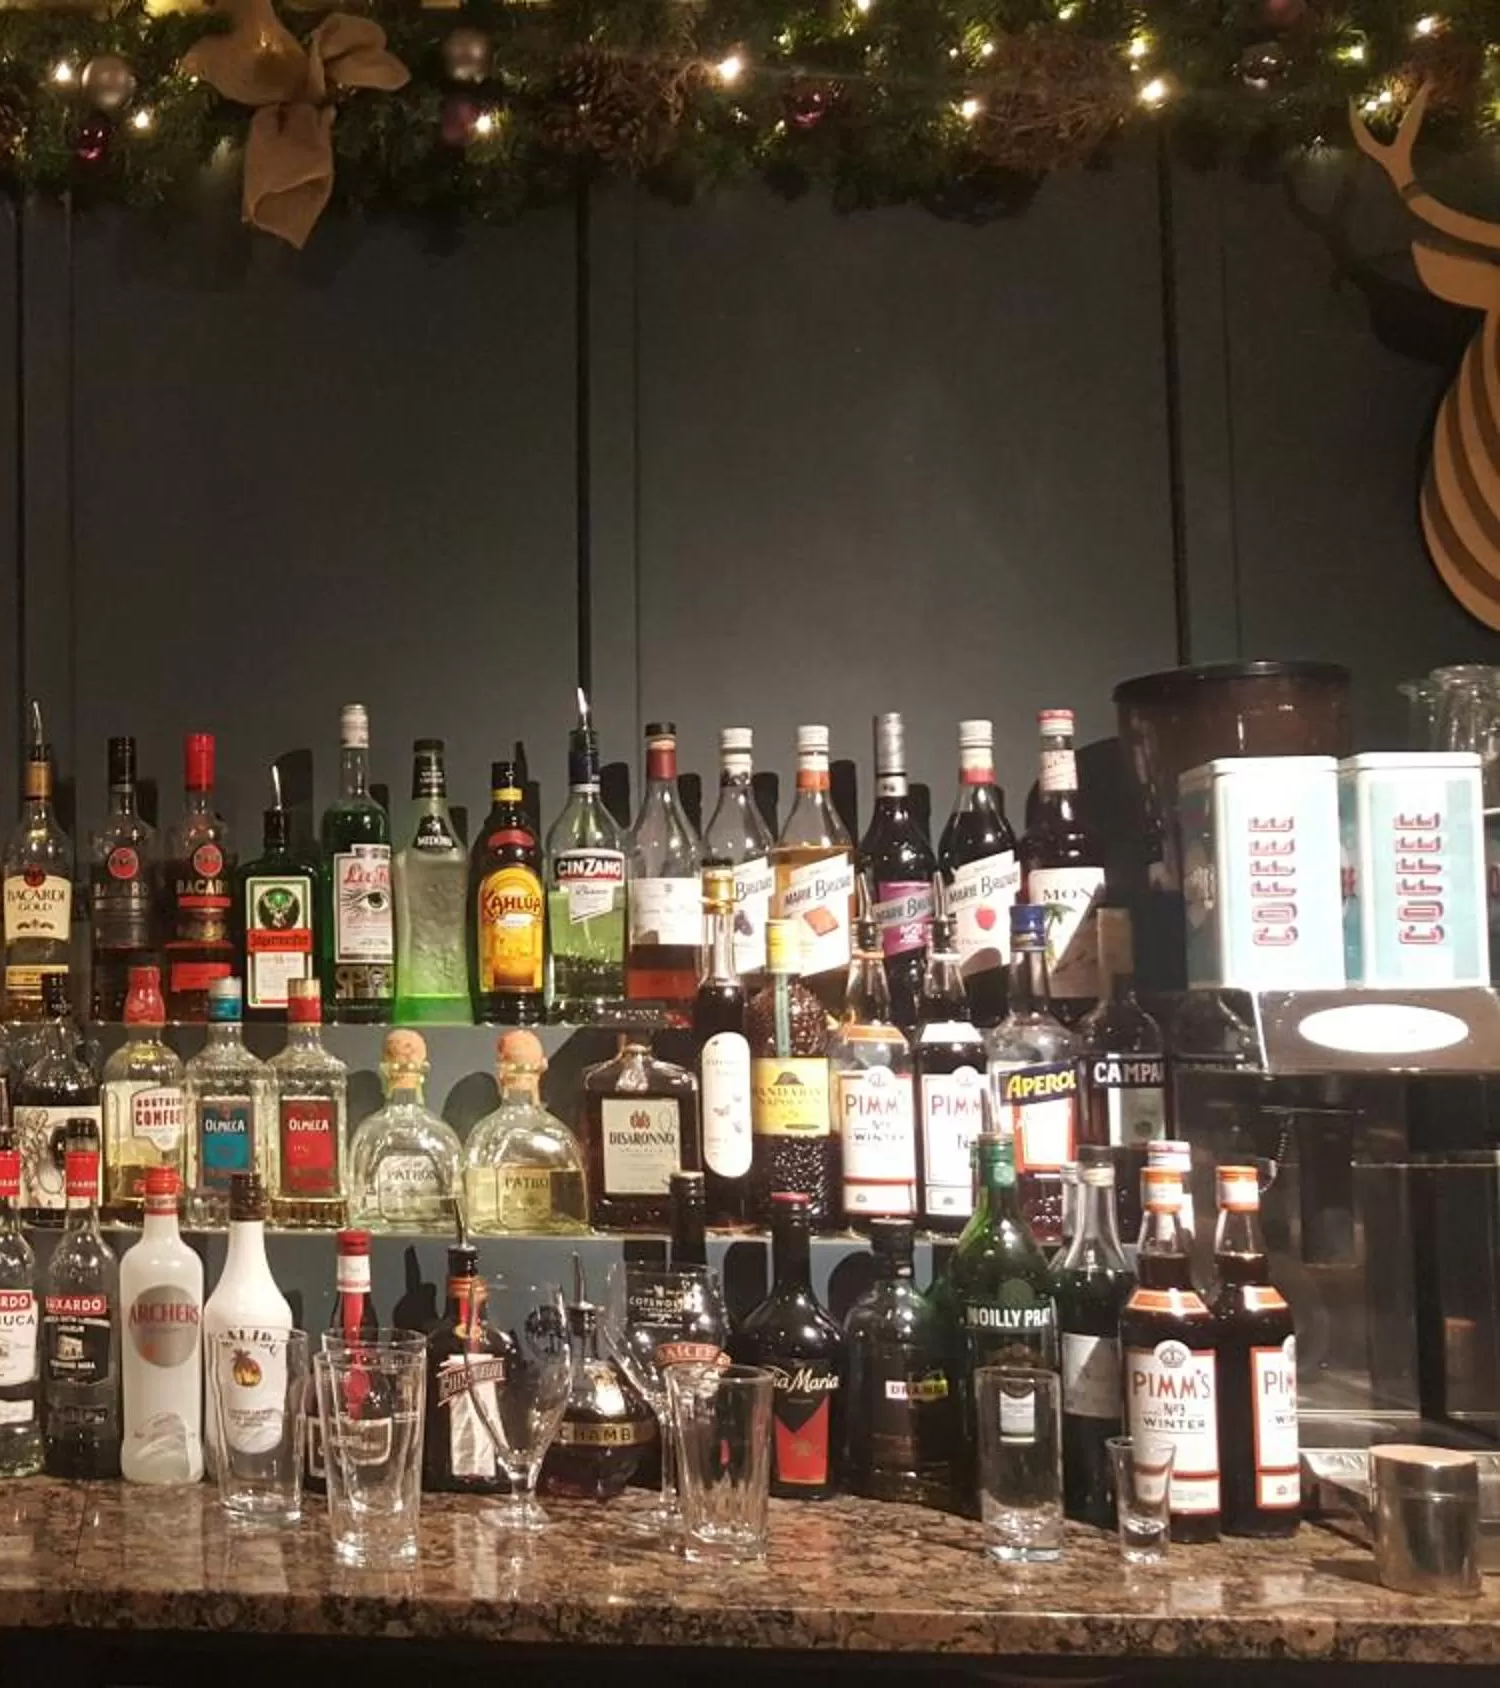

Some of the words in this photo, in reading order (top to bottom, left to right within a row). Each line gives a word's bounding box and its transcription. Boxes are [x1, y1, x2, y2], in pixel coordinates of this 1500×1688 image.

[557, 859, 621, 877] CINZANO
[1394, 813, 1445, 945] COFFEE
[1248, 816, 1299, 946] COFFEE
[1006, 1070, 1077, 1100] APEROL
[204, 1118, 245, 1133] OLMECA
[288, 1118, 329, 1132] OLMECA
[609, 1131, 675, 1146] DISARONNO
[128, 1302, 199, 1327] ARCHERS
[967, 1306, 1021, 1329] NOILLY
[787, 1367, 838, 1393] Maria
[1132, 1369, 1211, 1399] PIMM'S
[1142, 1417, 1206, 1429] WINTER
